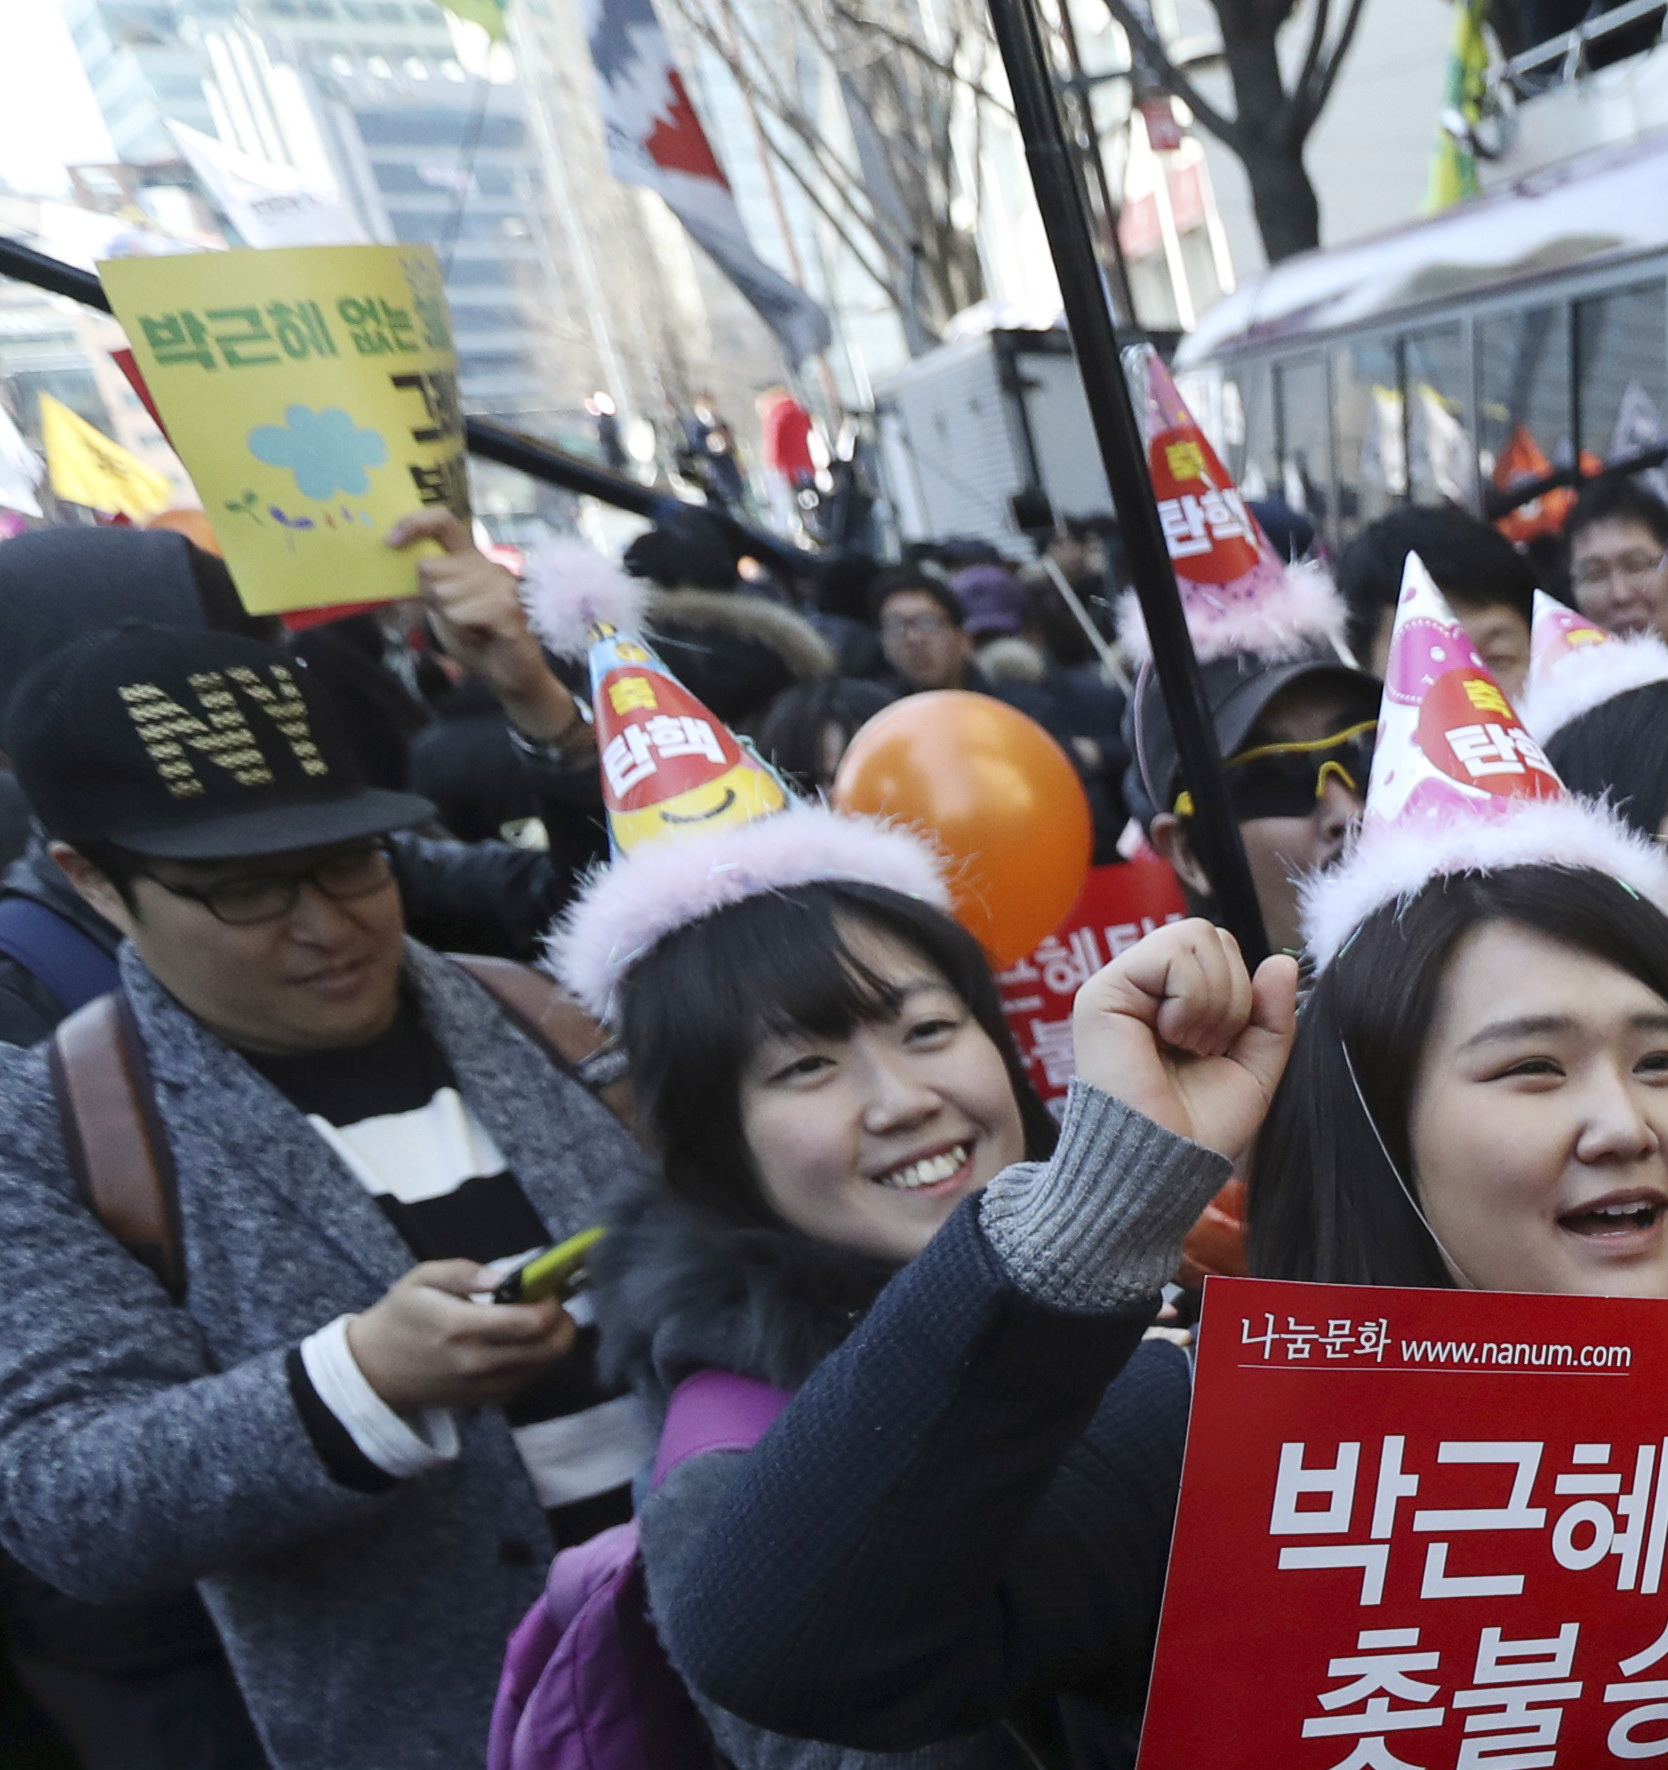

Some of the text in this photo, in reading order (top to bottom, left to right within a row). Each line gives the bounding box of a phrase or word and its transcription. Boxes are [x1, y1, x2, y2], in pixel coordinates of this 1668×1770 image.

[136, 298, 340, 372] 박근혜
[118, 664, 329, 798] NY
[602, 715, 727, 799] 탄핵
[1241, 1312, 1632, 1368] 나눔문화 www.nanum.com
